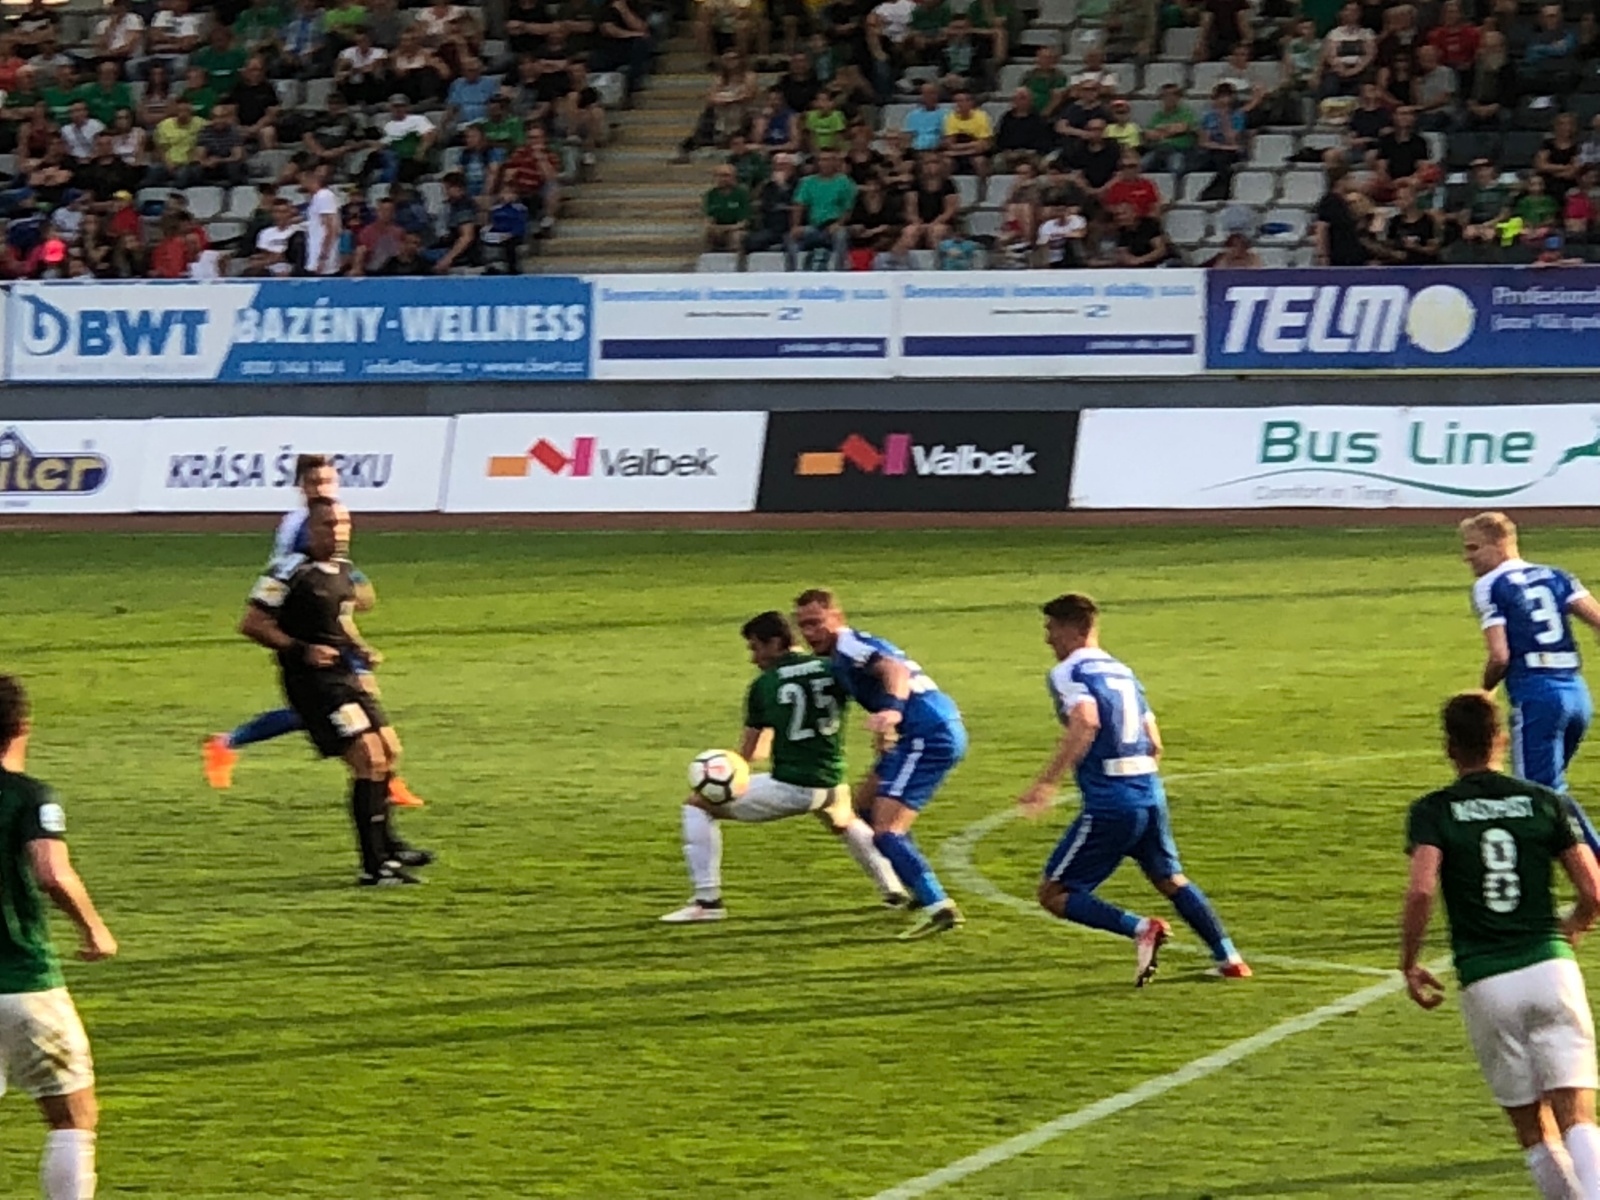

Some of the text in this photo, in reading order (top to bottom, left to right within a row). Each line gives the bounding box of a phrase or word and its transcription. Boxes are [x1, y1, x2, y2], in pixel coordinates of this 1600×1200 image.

[78, 309, 209, 356] BWT
[600, 447, 718, 477] Valbek
[911, 444, 1036, 475] Valbek
[1259, 420, 1536, 465] Bus Line
[166, 444, 394, 488] KRÁSA ŠRKU
[1523, 584, 1564, 644] 3
[776, 677, 840, 741] 25
[1480, 827, 1521, 913] 8
